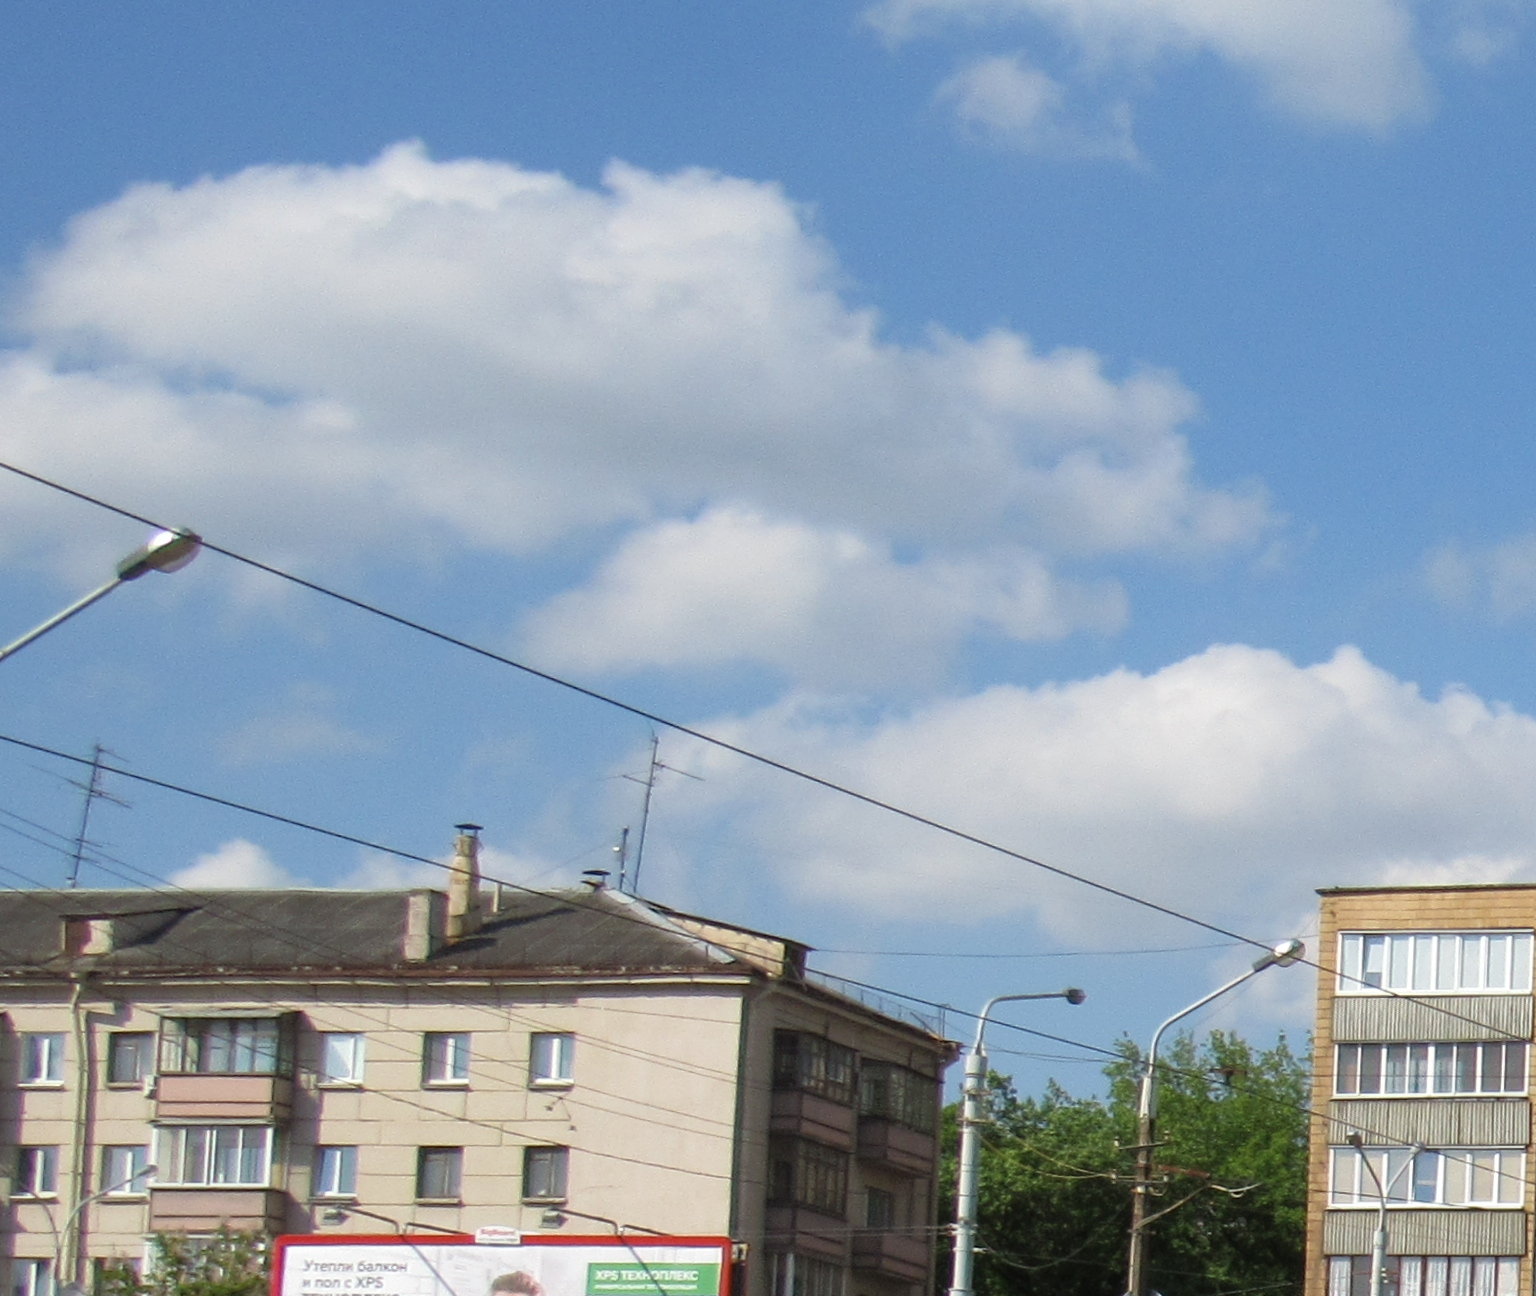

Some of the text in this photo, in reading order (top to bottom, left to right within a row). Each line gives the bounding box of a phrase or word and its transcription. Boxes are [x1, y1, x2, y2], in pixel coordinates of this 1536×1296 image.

[302, 1260, 408, 1272] Утепли балкон
[314, 1278, 341, 1288] пол
[355, 1276, 384, 1288] XPS
